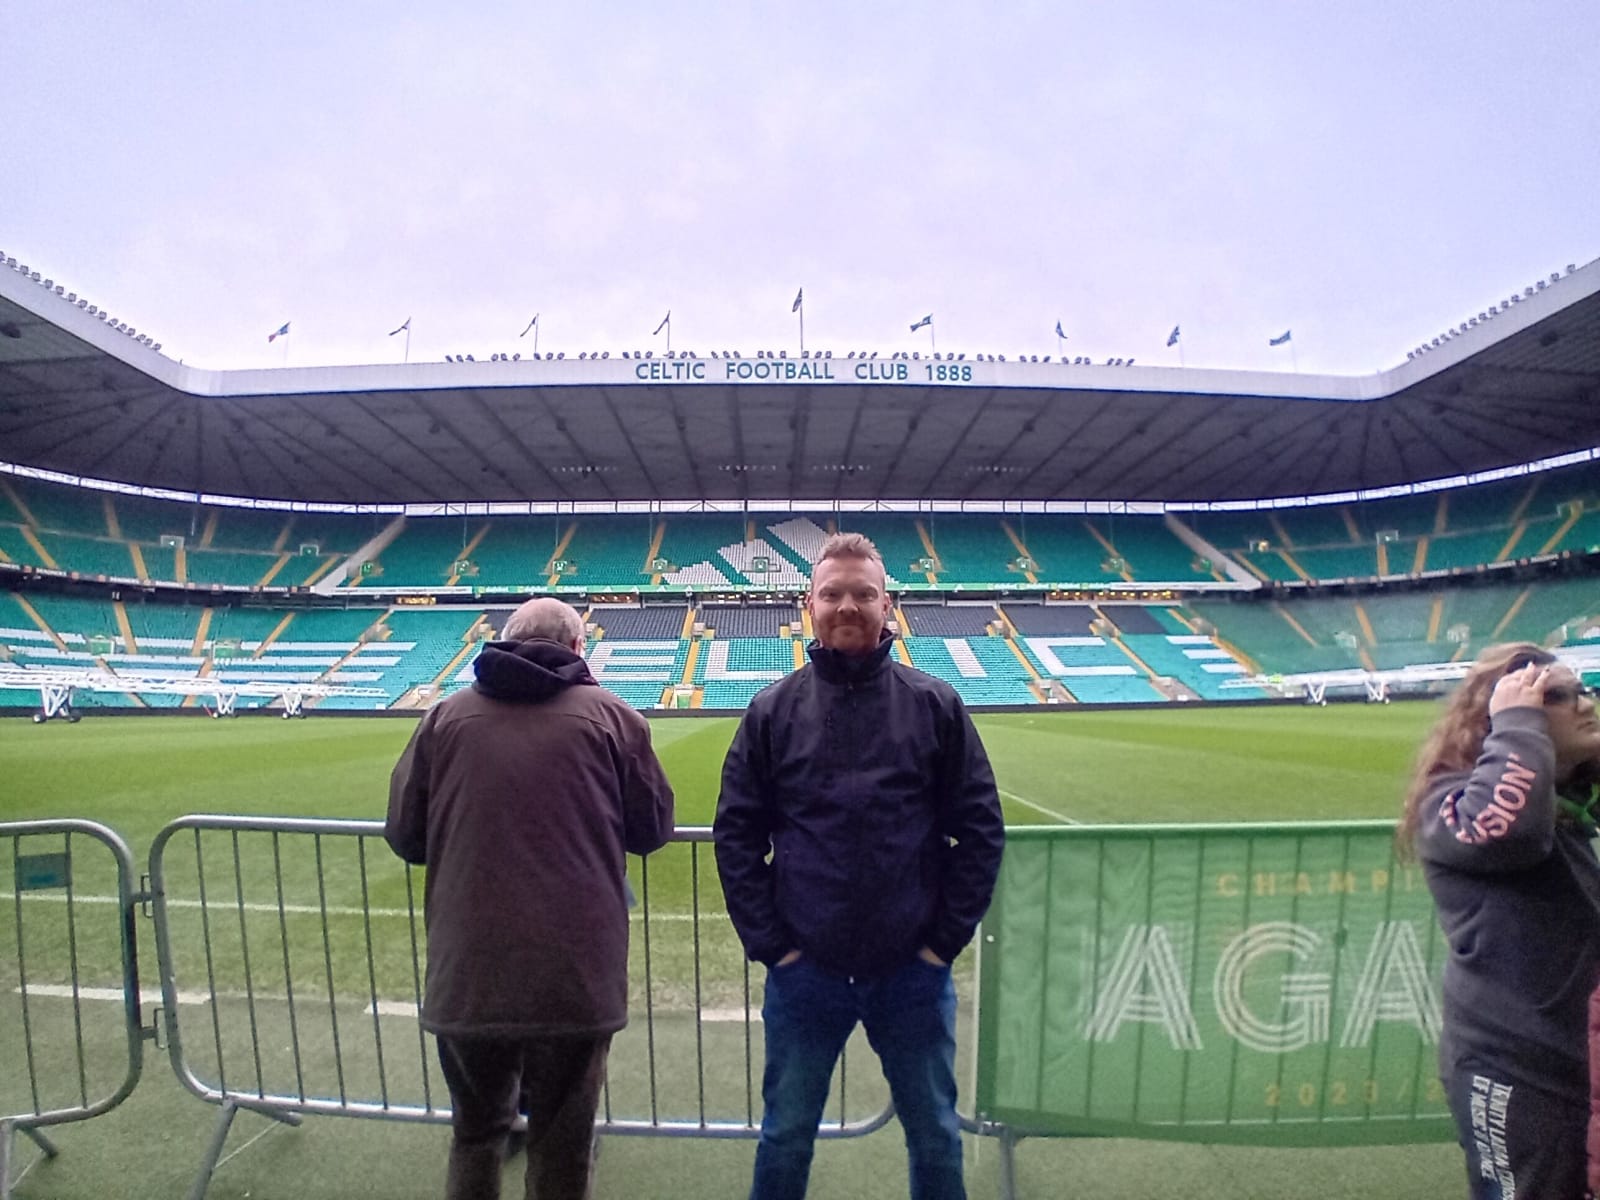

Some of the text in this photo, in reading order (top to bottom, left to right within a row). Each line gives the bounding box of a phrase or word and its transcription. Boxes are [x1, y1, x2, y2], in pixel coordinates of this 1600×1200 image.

[635, 362, 973, 382] CELTIC FOOTBALL CLUB 1888
